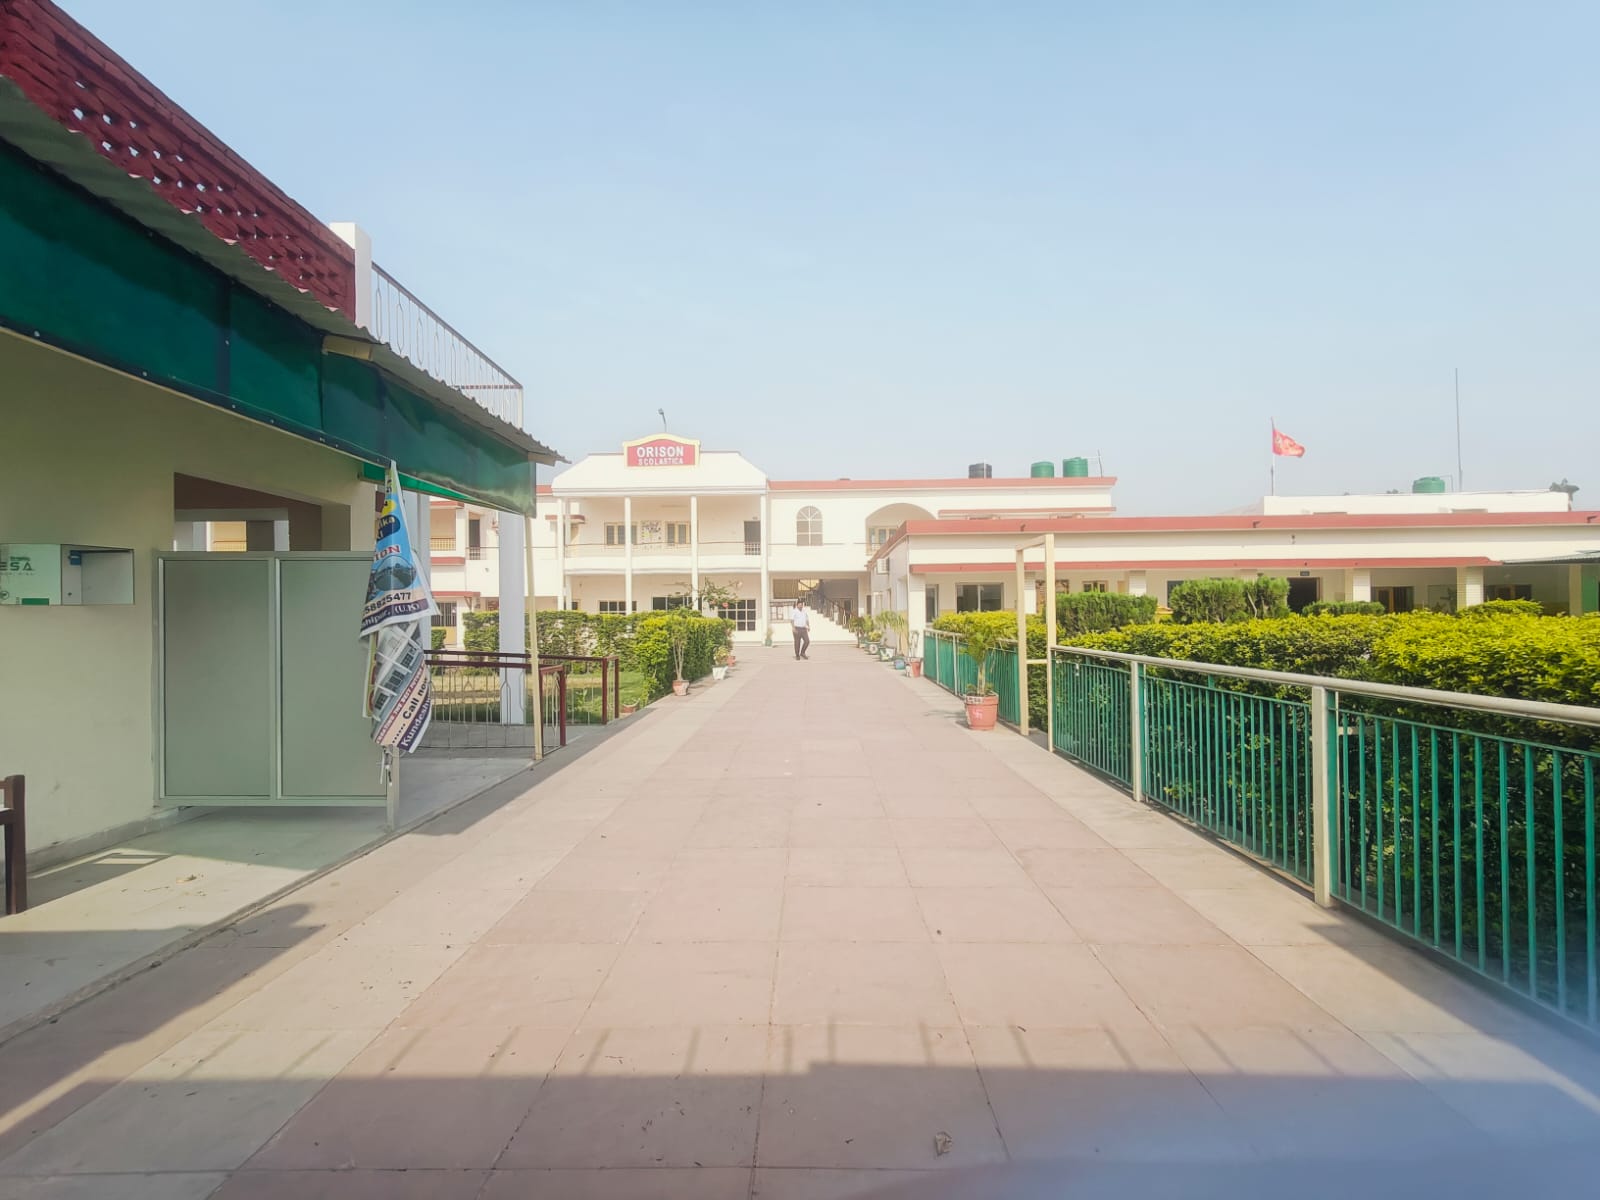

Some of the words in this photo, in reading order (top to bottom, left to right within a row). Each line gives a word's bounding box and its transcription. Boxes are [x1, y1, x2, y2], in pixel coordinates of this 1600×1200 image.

[637, 446, 684, 458] ORISON
[638, 457, 684, 466] SCOLASTICA
[403, 698, 419, 719] Call
